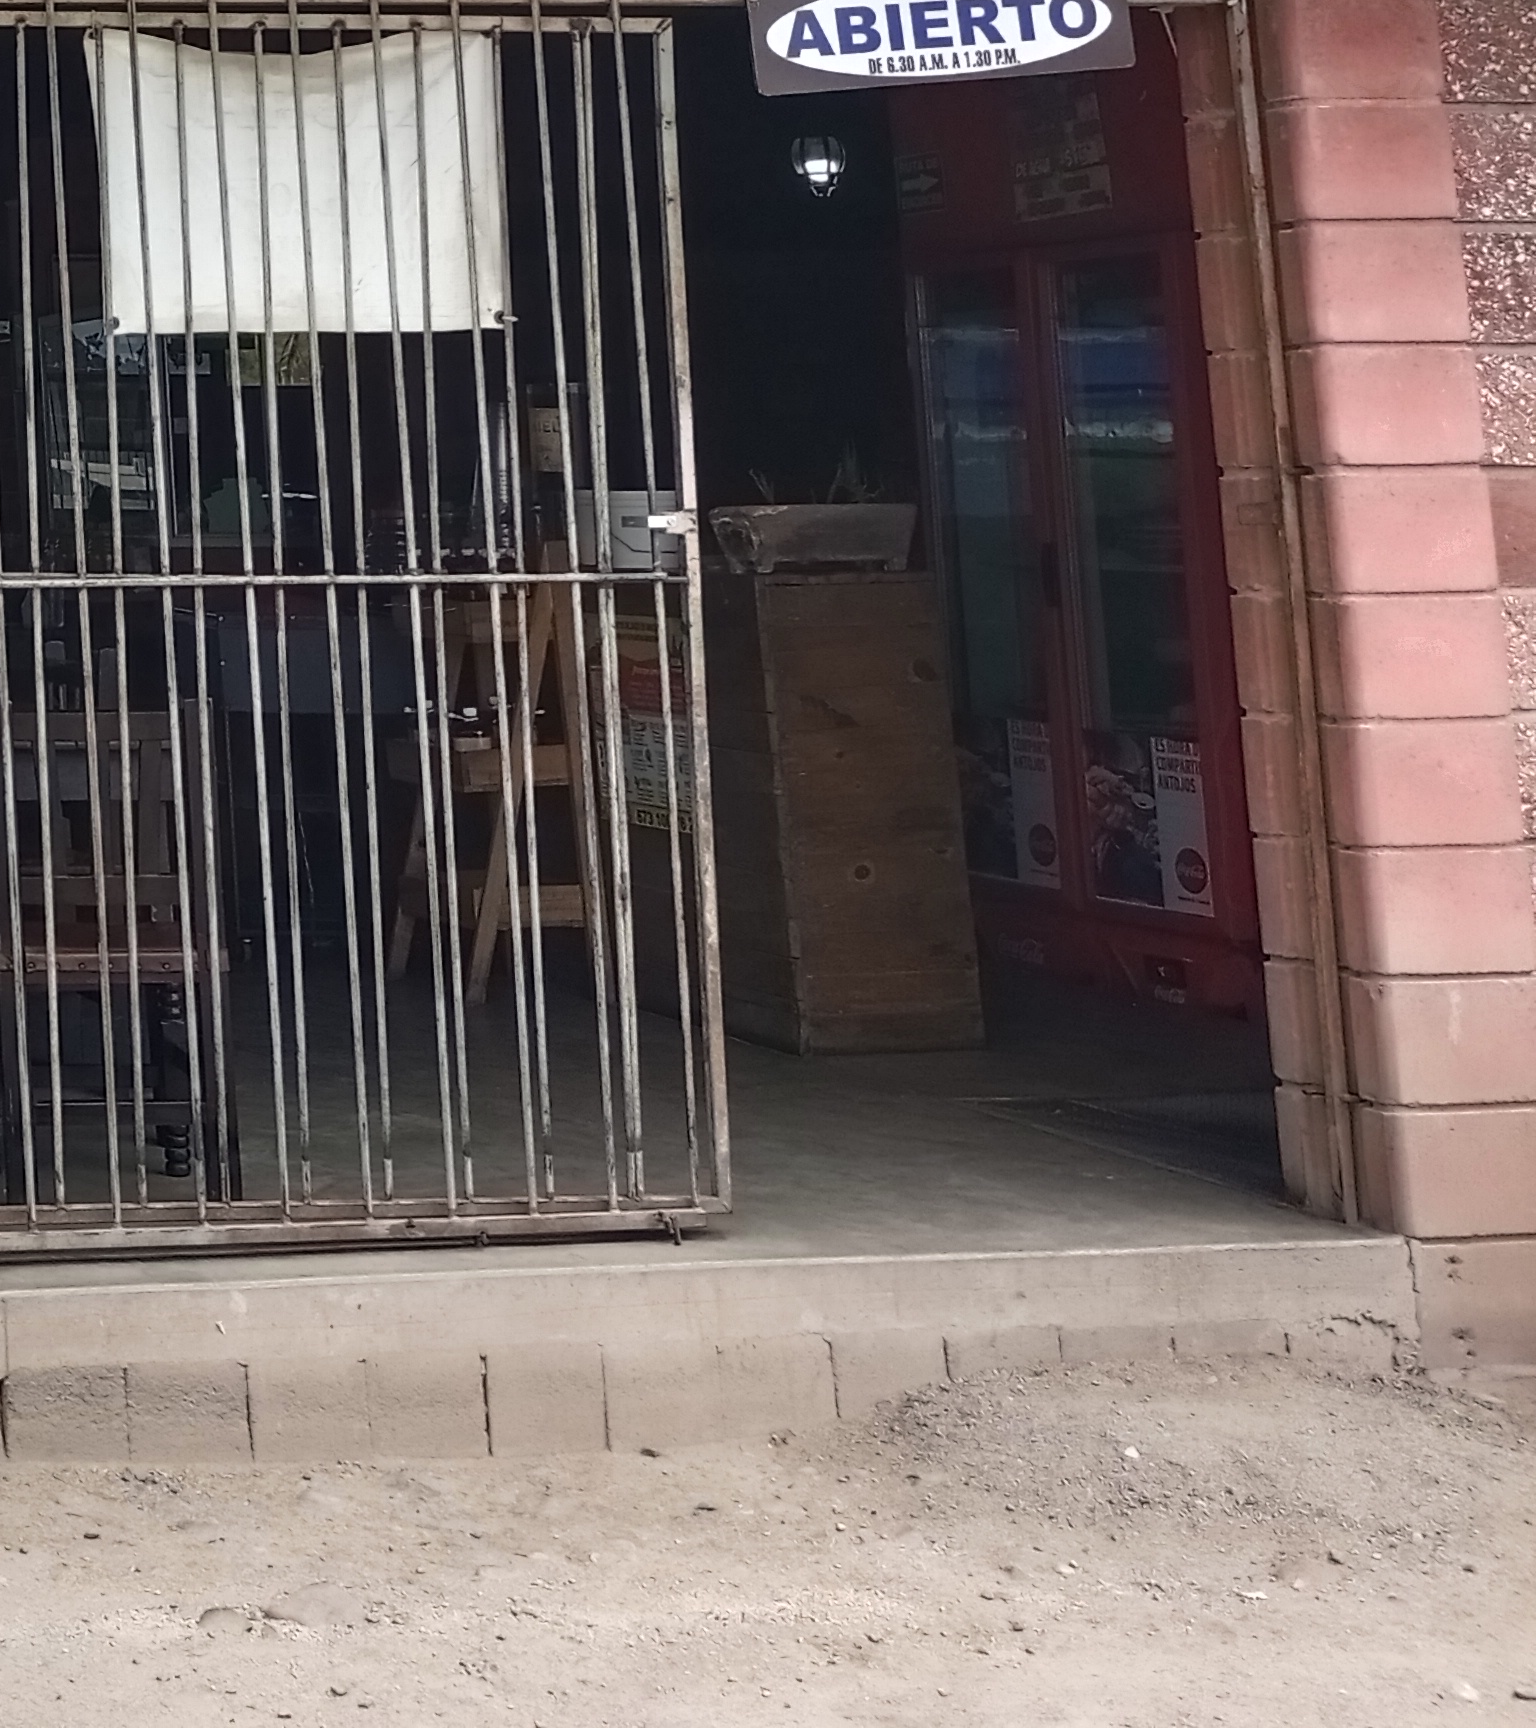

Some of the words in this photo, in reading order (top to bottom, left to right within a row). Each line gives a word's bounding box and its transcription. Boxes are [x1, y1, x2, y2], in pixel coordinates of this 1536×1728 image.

[868, 58, 883, 74] DE
[919, 53, 949, 72] A.M.
[952, 51, 961, 69] A
[964, 49, 993, 68] 1.30
[994, 47, 1022, 65] P.M.
